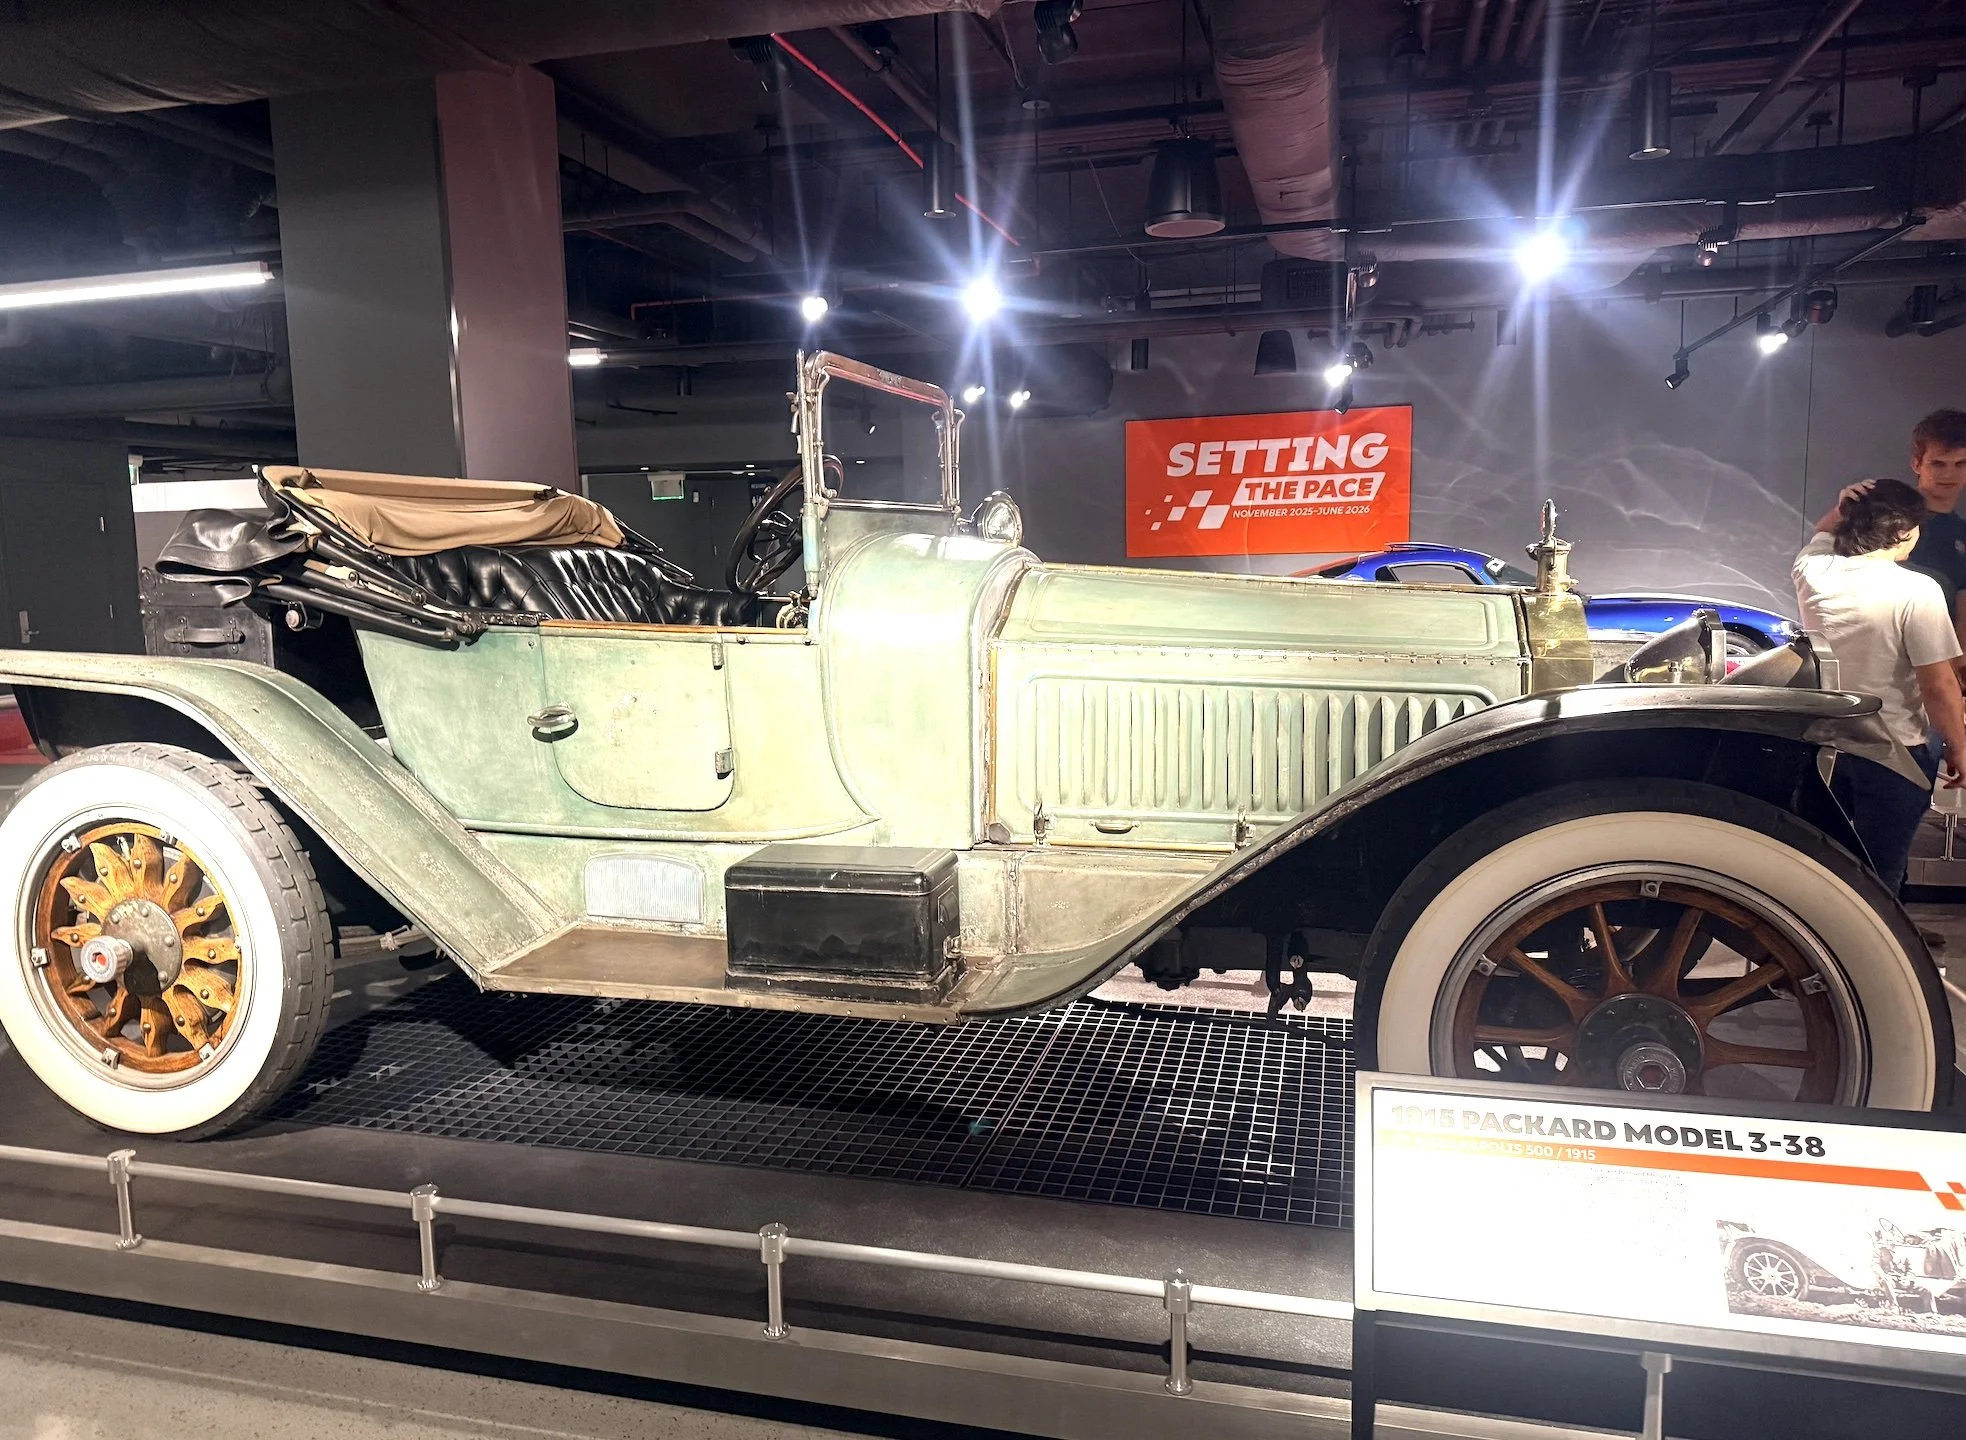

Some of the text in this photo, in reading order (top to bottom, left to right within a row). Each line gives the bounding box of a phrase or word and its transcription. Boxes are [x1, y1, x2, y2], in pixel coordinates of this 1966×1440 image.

[1166, 432, 1389, 477] SETTING
[1244, 477, 1374, 501] THE PACE
[1232, 507, 1288, 518] NOVEMBER
[1345, 504, 1371, 515] 2026
[1391, 1105, 1827, 1158] 1915 PACKARD MODEL 3-38
[1526, 1143, 1554, 1158] 500
[1565, 1147, 1597, 1161] 1915
